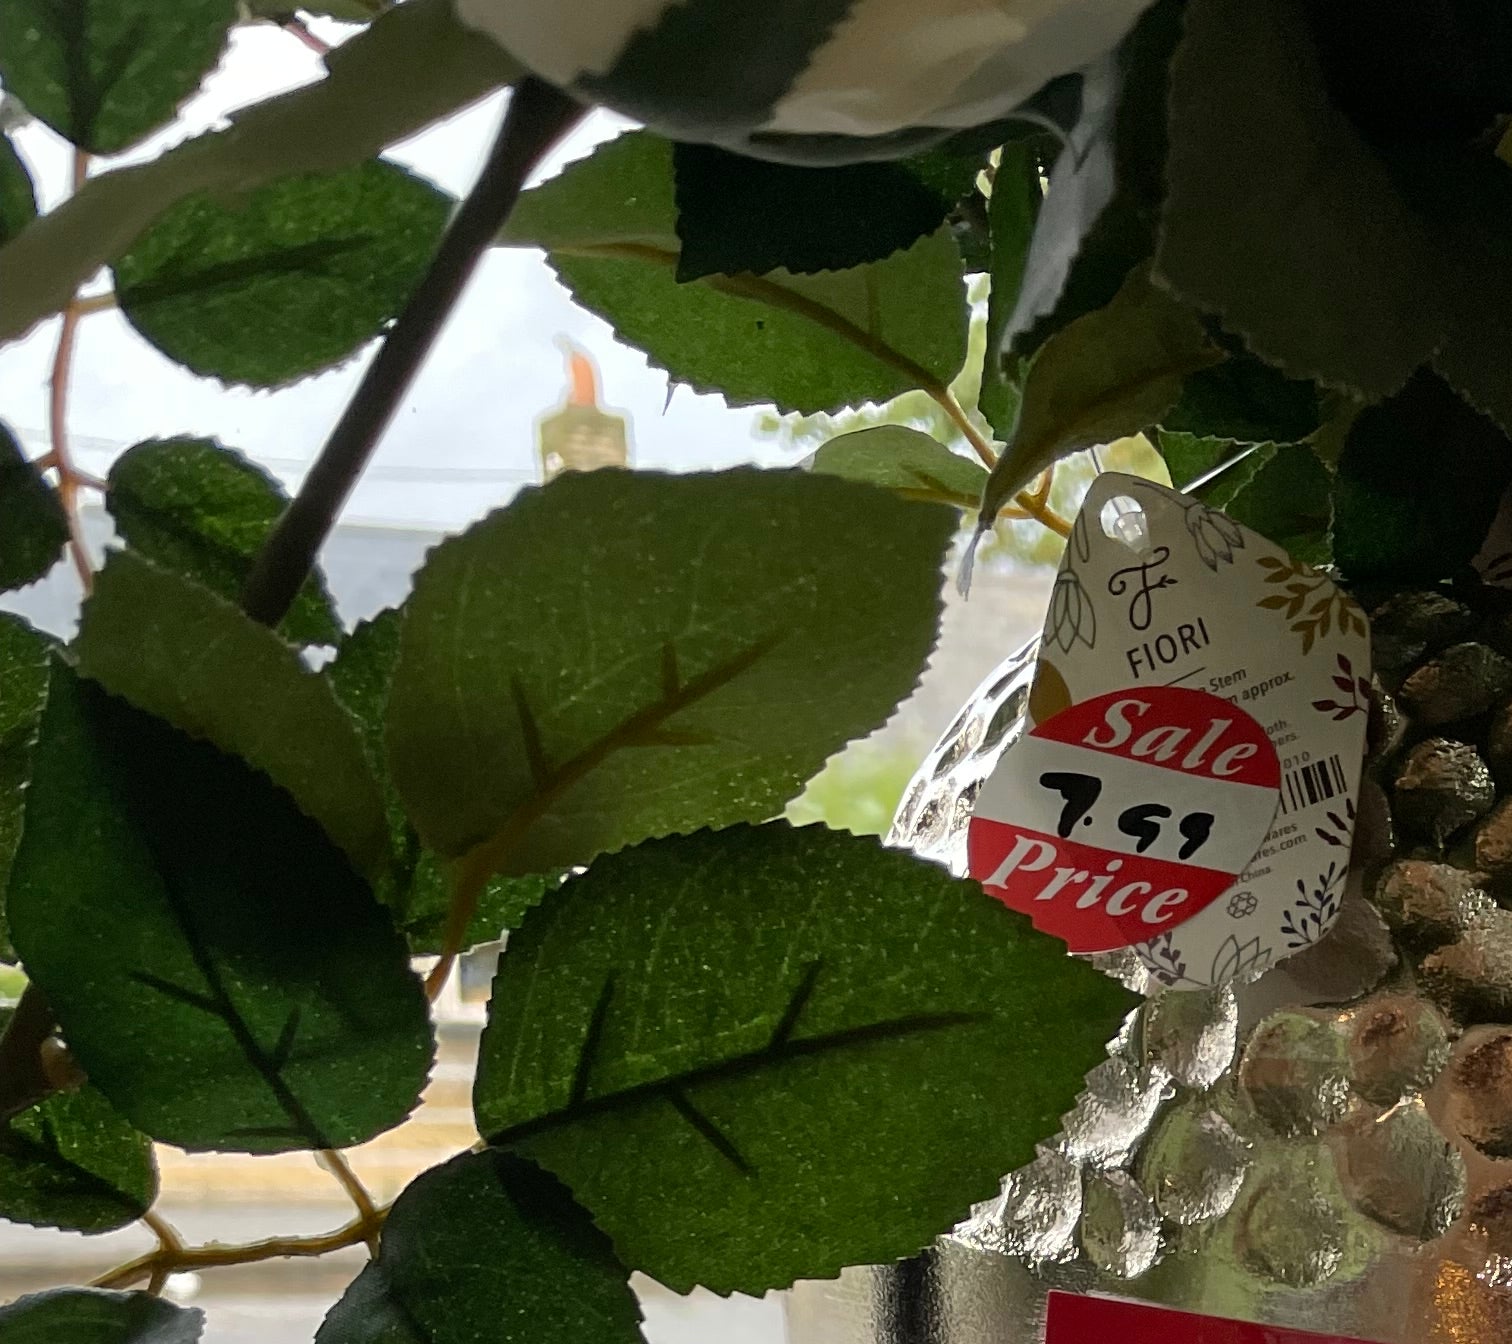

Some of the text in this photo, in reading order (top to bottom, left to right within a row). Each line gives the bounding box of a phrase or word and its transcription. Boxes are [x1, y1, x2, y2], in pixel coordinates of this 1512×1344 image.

[1126, 618, 1211, 678] FIORI
[1210, 669, 1247, 692] Stem
[1082, 698, 1259, 777] Sale
[982, 834, 1189, 924] Price
